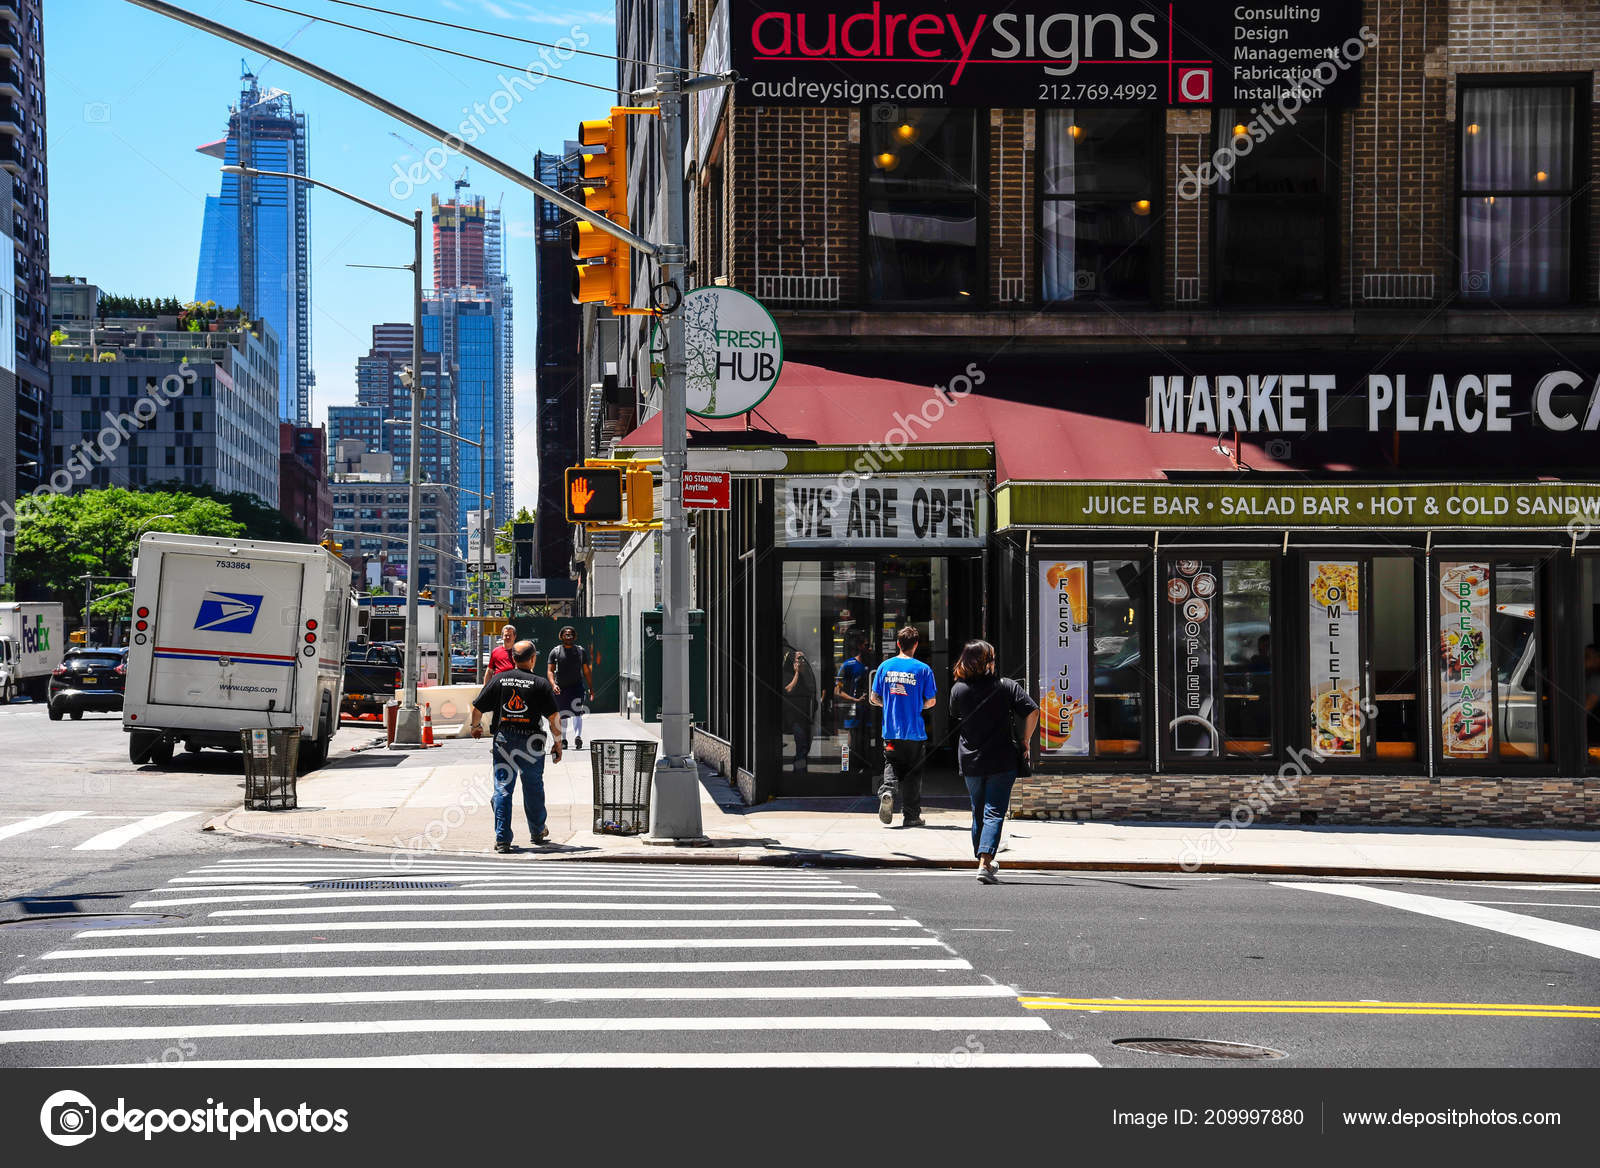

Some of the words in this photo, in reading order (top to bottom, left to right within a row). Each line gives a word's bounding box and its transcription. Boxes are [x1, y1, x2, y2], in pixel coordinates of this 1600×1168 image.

[1235, 5, 1320, 22] Consulting
[752, 1, 1158, 85] audreysigns
[1235, 26, 1289, 43] Design
[1235, 46, 1340, 62] Management
[1235, 65, 1322, 80] Fabrication
[752, 77, 943, 103] audreysigns.com
[1039, 84, 1157, 100] 212.769.4992
[1181, 69, 1209, 100] a
[1235, 84, 1323, 100] Installation
[716, 330, 777, 348] FRESH
[716, 352, 776, 382] HUB
[1146, 374, 1336, 433] MARKET
[1368, 374, 1512, 433] PLACE
[684, 474, 693, 482] NO
[694, 475, 723, 484] STANDING
[685, 484, 709, 493] Anytime
[792, 488, 833, 538] WE
[846, 488, 899, 538] ARE
[911, 487, 980, 538] OPEN
[1082, 496, 1146, 515] JUICE
[1154, 496, 1200, 515] BAR
[1220, 496, 1296, 515] SALAD
[1303, 496, 1350, 515] BAR
[1371, 496, 1417, 515] HOT
[1424, 496, 1440, 515] &
[1446, 496, 1509, 515] COLD
[216, 560, 251, 570] 7533864
[1058, 578, 1069, 648] FRESH
[22, 614, 50, 654] FedEx
[1185, 603, 1201, 710] COFFEE
[1327, 586, 1342, 727] OMELETTE
[1459, 582, 1474, 736] BREAKFAST
[219, 684, 278, 694] www.usps.com
[1059, 664, 1070, 735] JUICE
